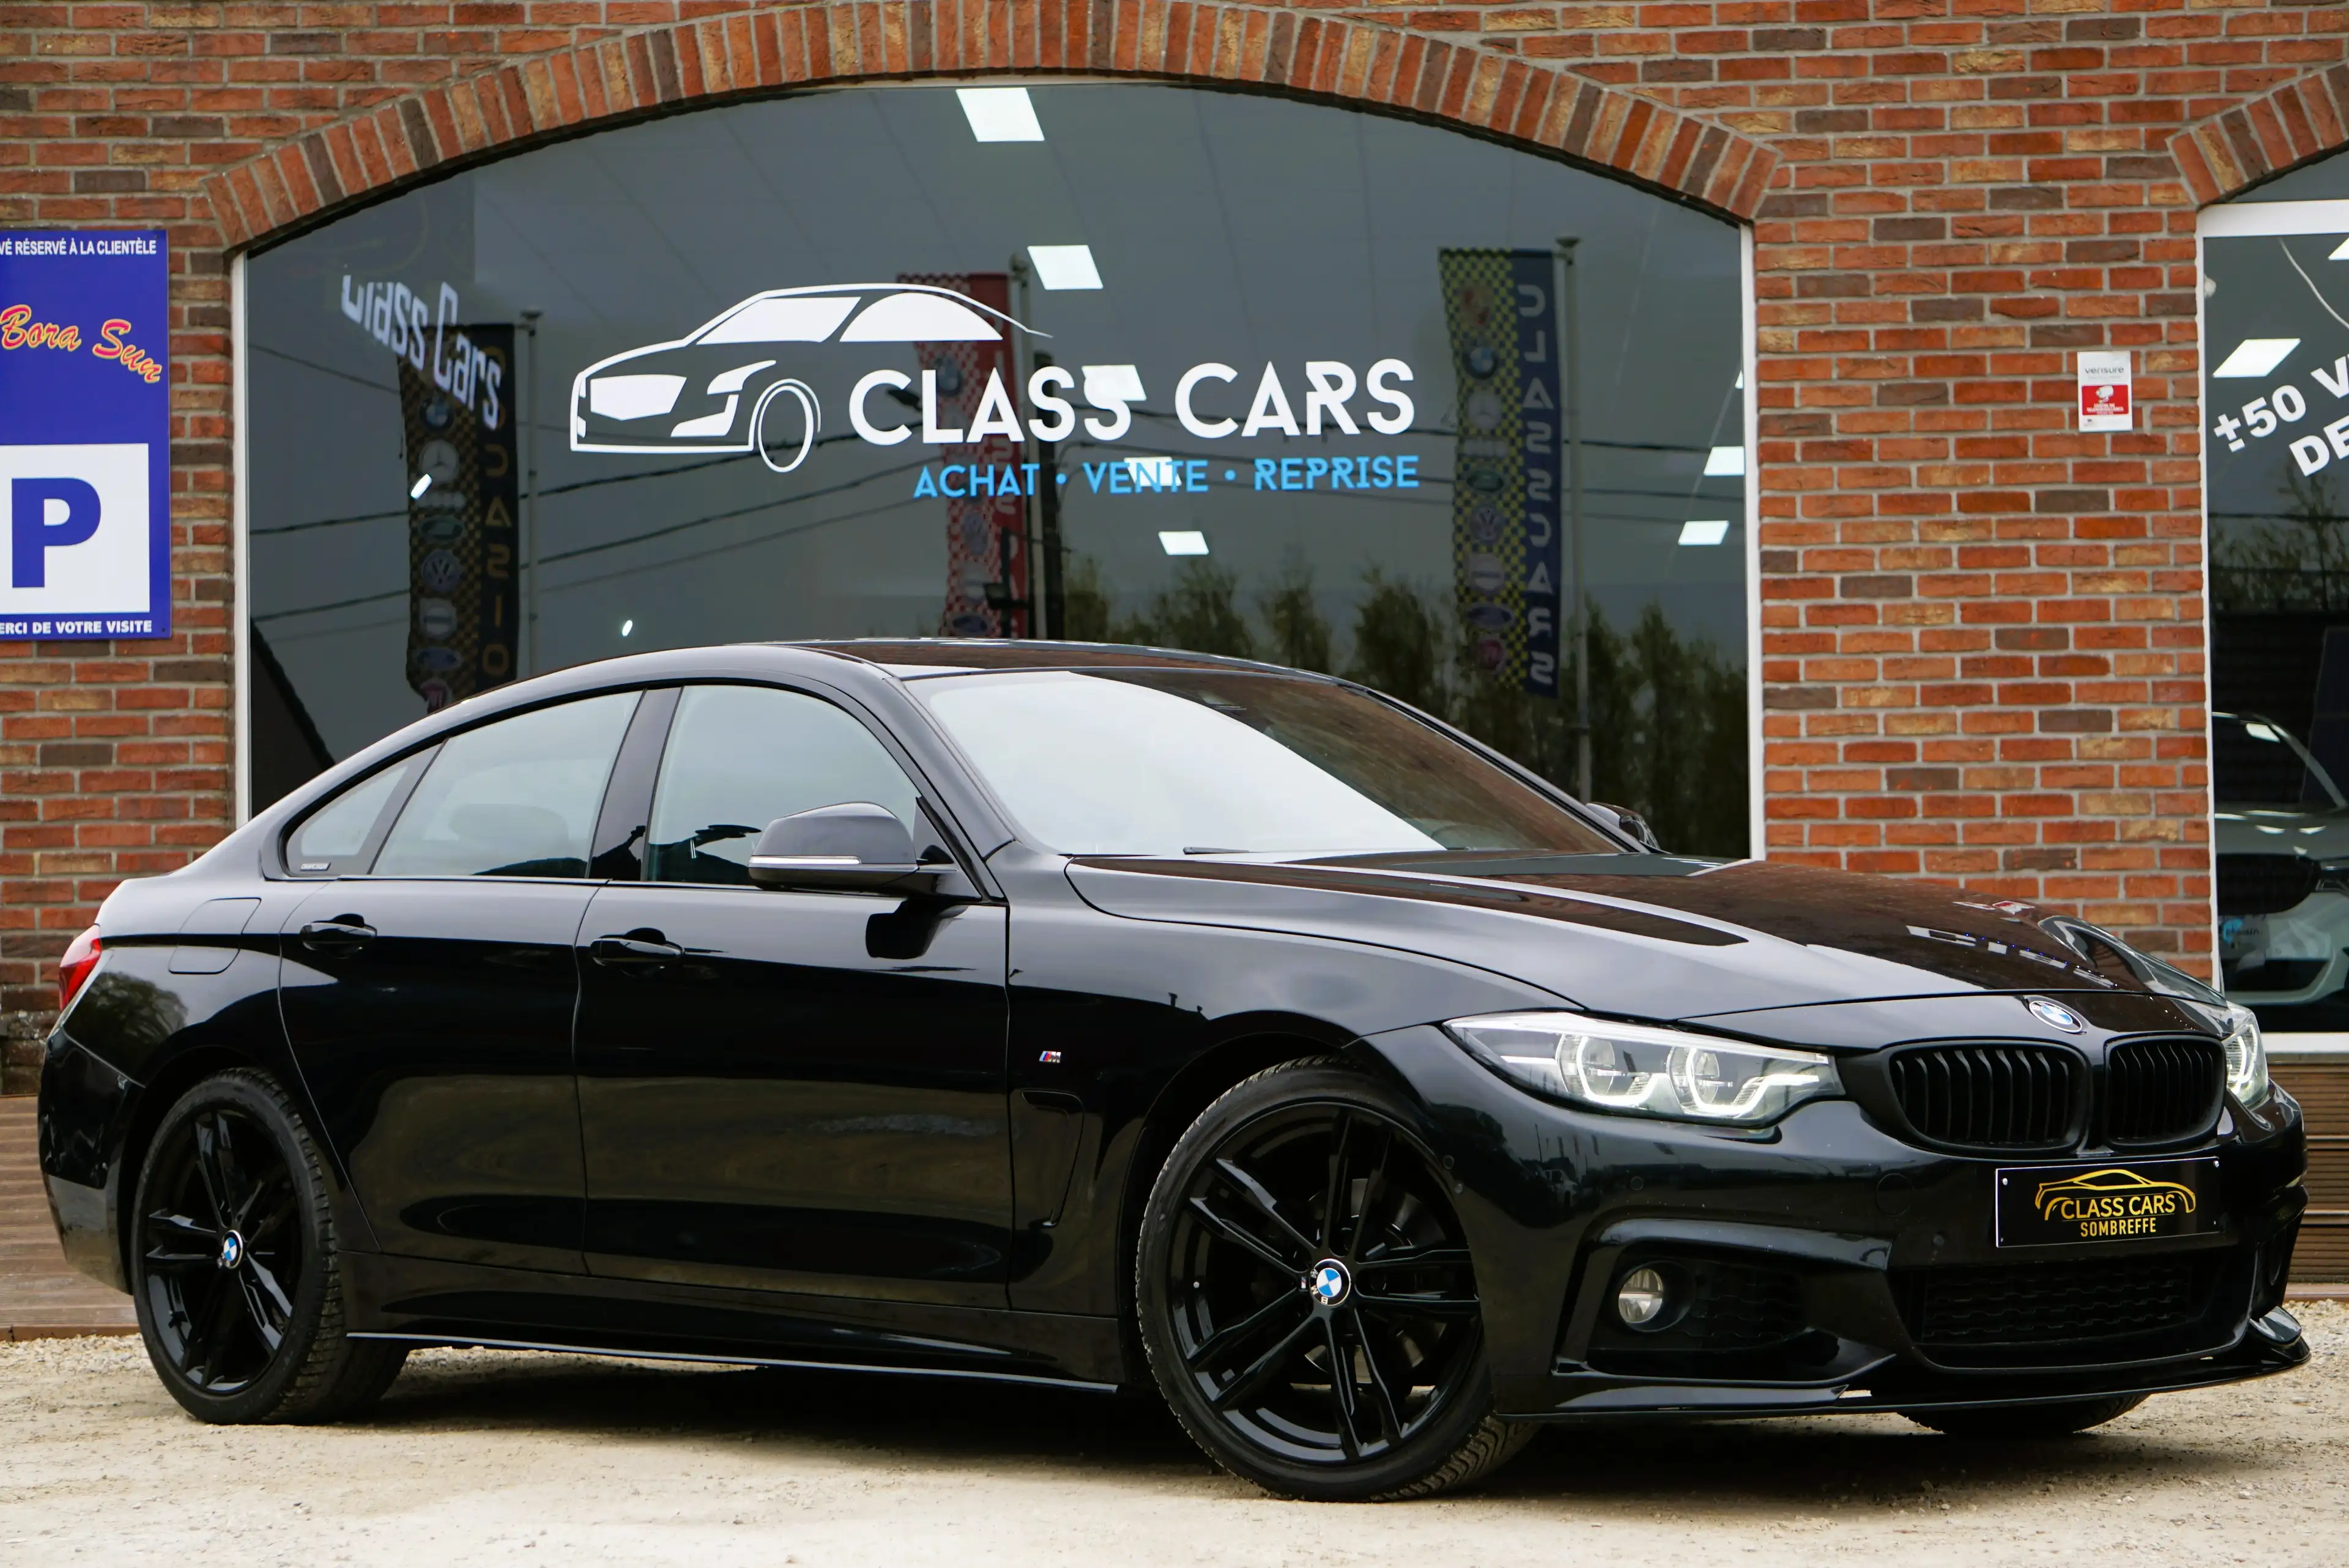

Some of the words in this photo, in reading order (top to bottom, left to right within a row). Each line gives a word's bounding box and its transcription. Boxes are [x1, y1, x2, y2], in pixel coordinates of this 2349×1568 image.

[15, 237, 67, 256] RÉSERVÉ
[69, 237, 78, 255] À
[80, 240, 95, 255] LA
[97, 237, 157, 255] CLIENTÈLE
[0, 304, 82, 352] Bora
[92, 318, 163, 383] Sun
[434, 281, 501, 431] Cars
[2310, 352, 2349, 399] V
[848, 366, 1132, 445] CLASS
[1174, 358, 1415, 439] CARS
[913, 462, 1040, 498] ACHAT
[1083, 459, 1209, 494] VENTE
[1254, 455, 1420, 491] REPRISE
[12, 477, 102, 588] P
[32, 621, 51, 635] DE
[56, 621, 102, 634] VOTRE
[106, 619, 152, 634] VISITE
[2061, 1197, 2124, 1220] CLASS
[2129, 1194, 2176, 1216] CARS
[2080, 1217, 2156, 1238] SOMBREFFE
